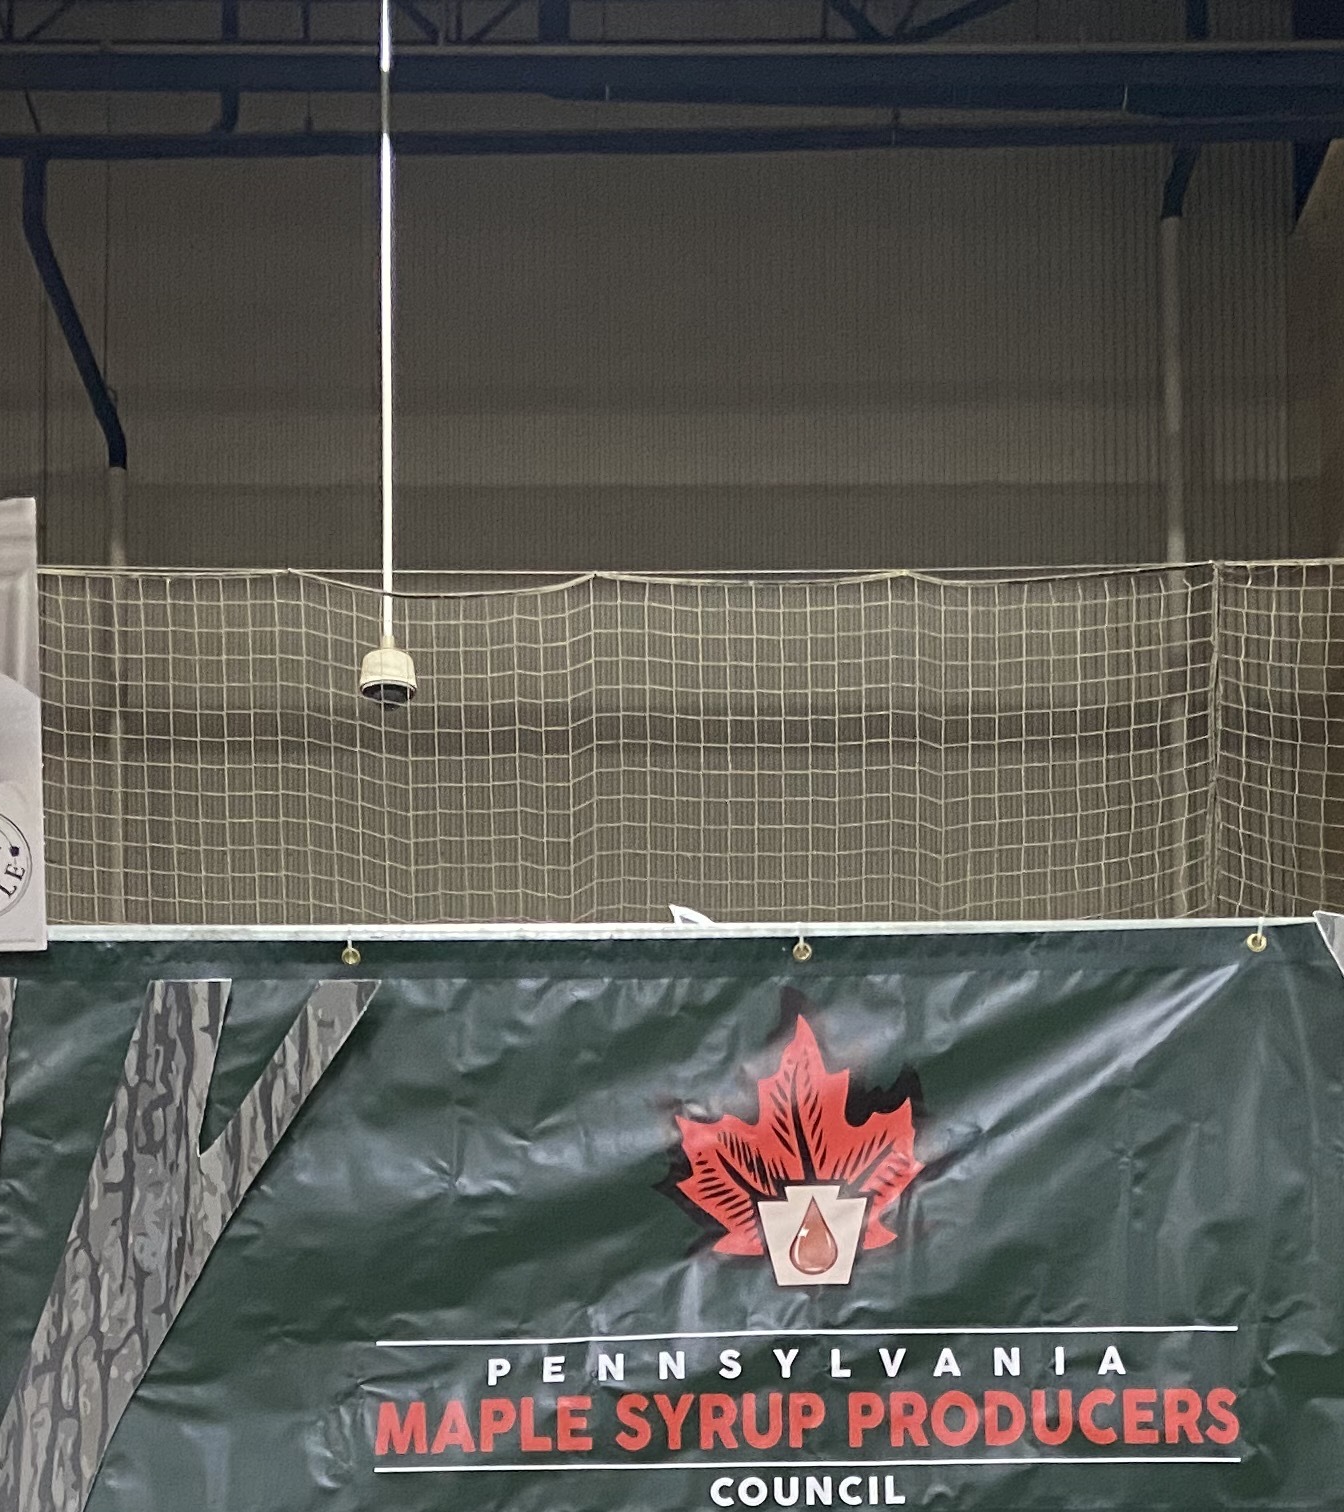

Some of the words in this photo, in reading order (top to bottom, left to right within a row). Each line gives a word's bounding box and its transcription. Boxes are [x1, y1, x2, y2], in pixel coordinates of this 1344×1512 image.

[486, 1345, 1127, 1387] PENNSYLVANIA
[374, 1395, 593, 1457] MAPLE
[615, 1391, 826, 1452] SYRUP
[846, 1387, 1239, 1449] PRODUCERS
[710, 1475, 906, 1507] COUNCIL
